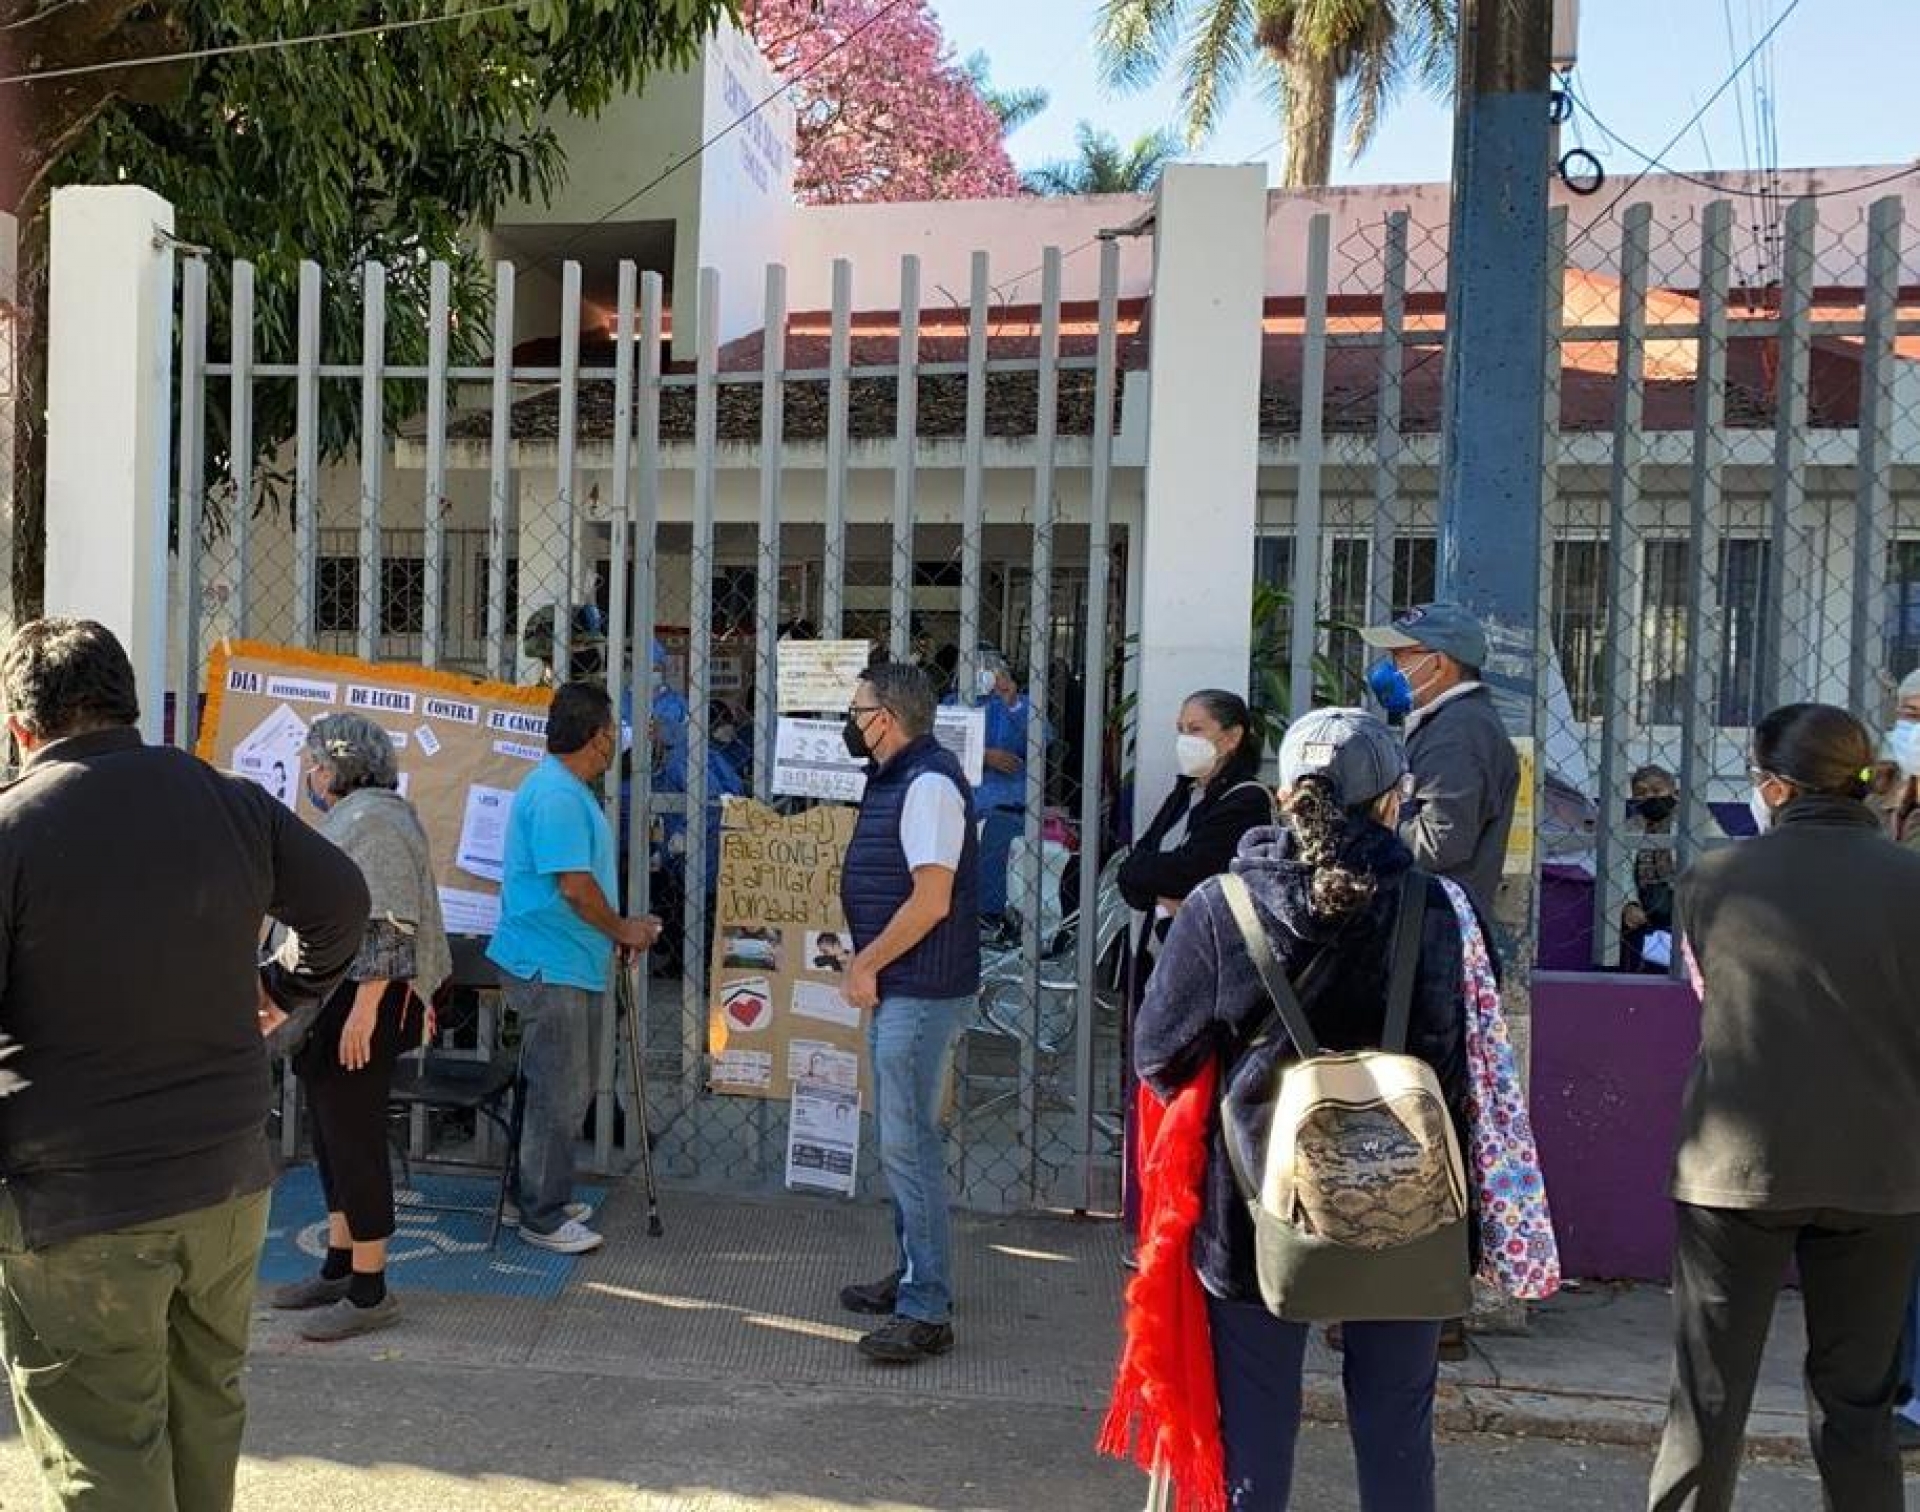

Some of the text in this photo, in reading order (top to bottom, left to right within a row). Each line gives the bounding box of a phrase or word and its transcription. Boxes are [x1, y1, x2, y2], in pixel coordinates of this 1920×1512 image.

[352, 688, 368, 701] DE
[371, 689, 411, 710] LUCHA
[427, 699, 474, 721] CONTRA
[493, 712, 504, 728] EL
[509, 716, 547, 734] CANCE
